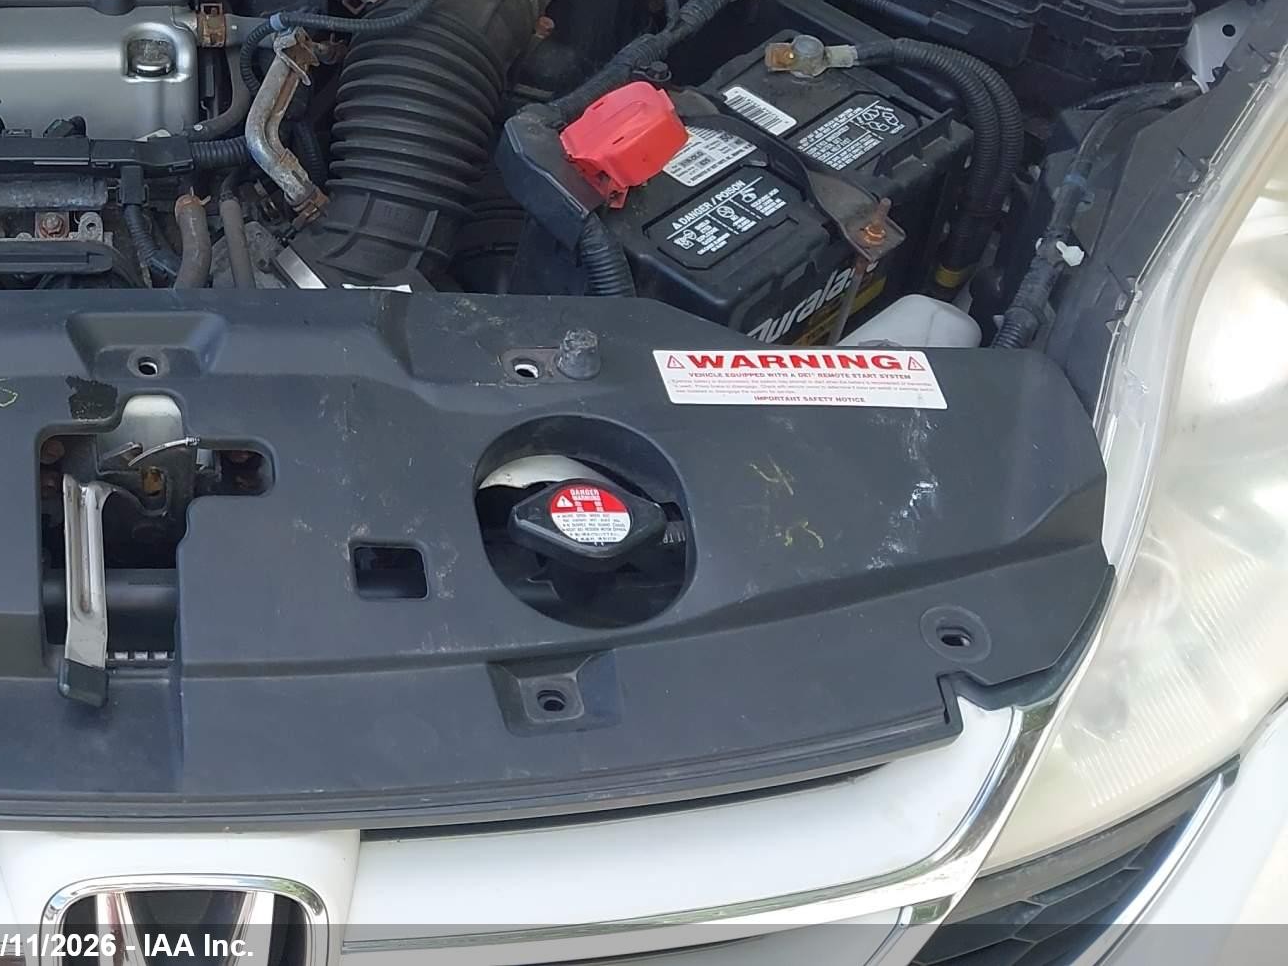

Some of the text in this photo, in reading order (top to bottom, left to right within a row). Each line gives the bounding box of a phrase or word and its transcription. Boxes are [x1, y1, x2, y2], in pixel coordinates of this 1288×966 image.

[678, 201, 714, 225] DANGER
[716, 180, 747, 209] POISON
[687, 354, 903, 370] WARNING
